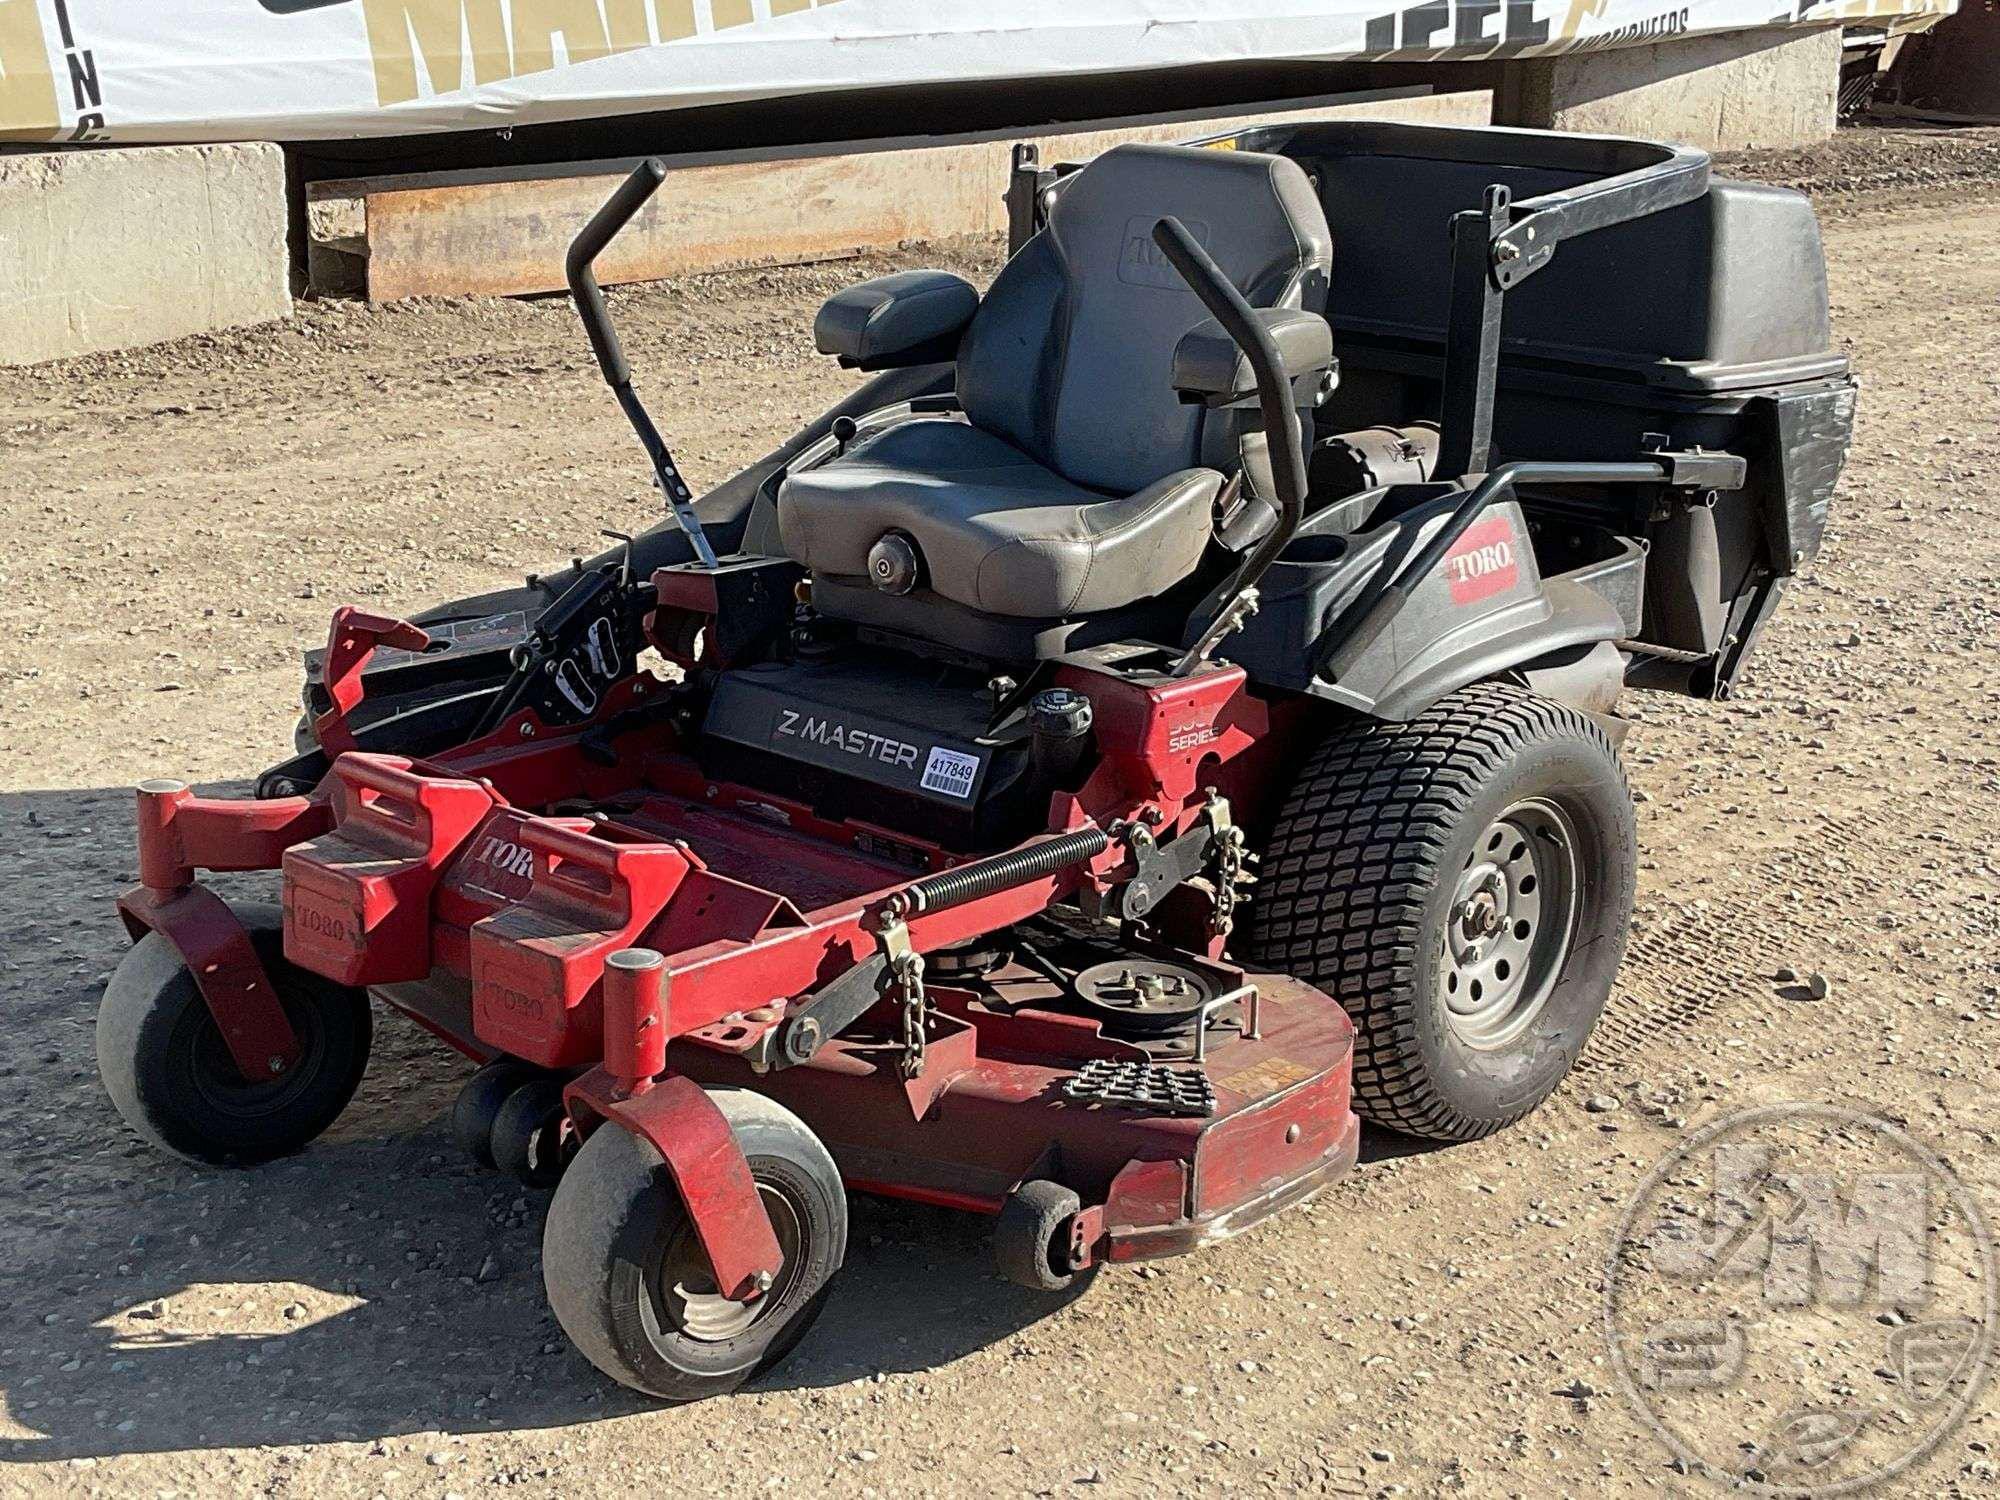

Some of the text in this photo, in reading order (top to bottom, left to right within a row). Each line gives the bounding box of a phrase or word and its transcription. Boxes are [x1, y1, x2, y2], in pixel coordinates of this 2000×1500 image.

[1452, 541, 1510, 582] TORO
[778, 709, 918, 770] Z MASTER
[1169, 727, 1219, 753] SERIES
[930, 758, 973, 780] 417849
[475, 835, 534, 880] TOR
